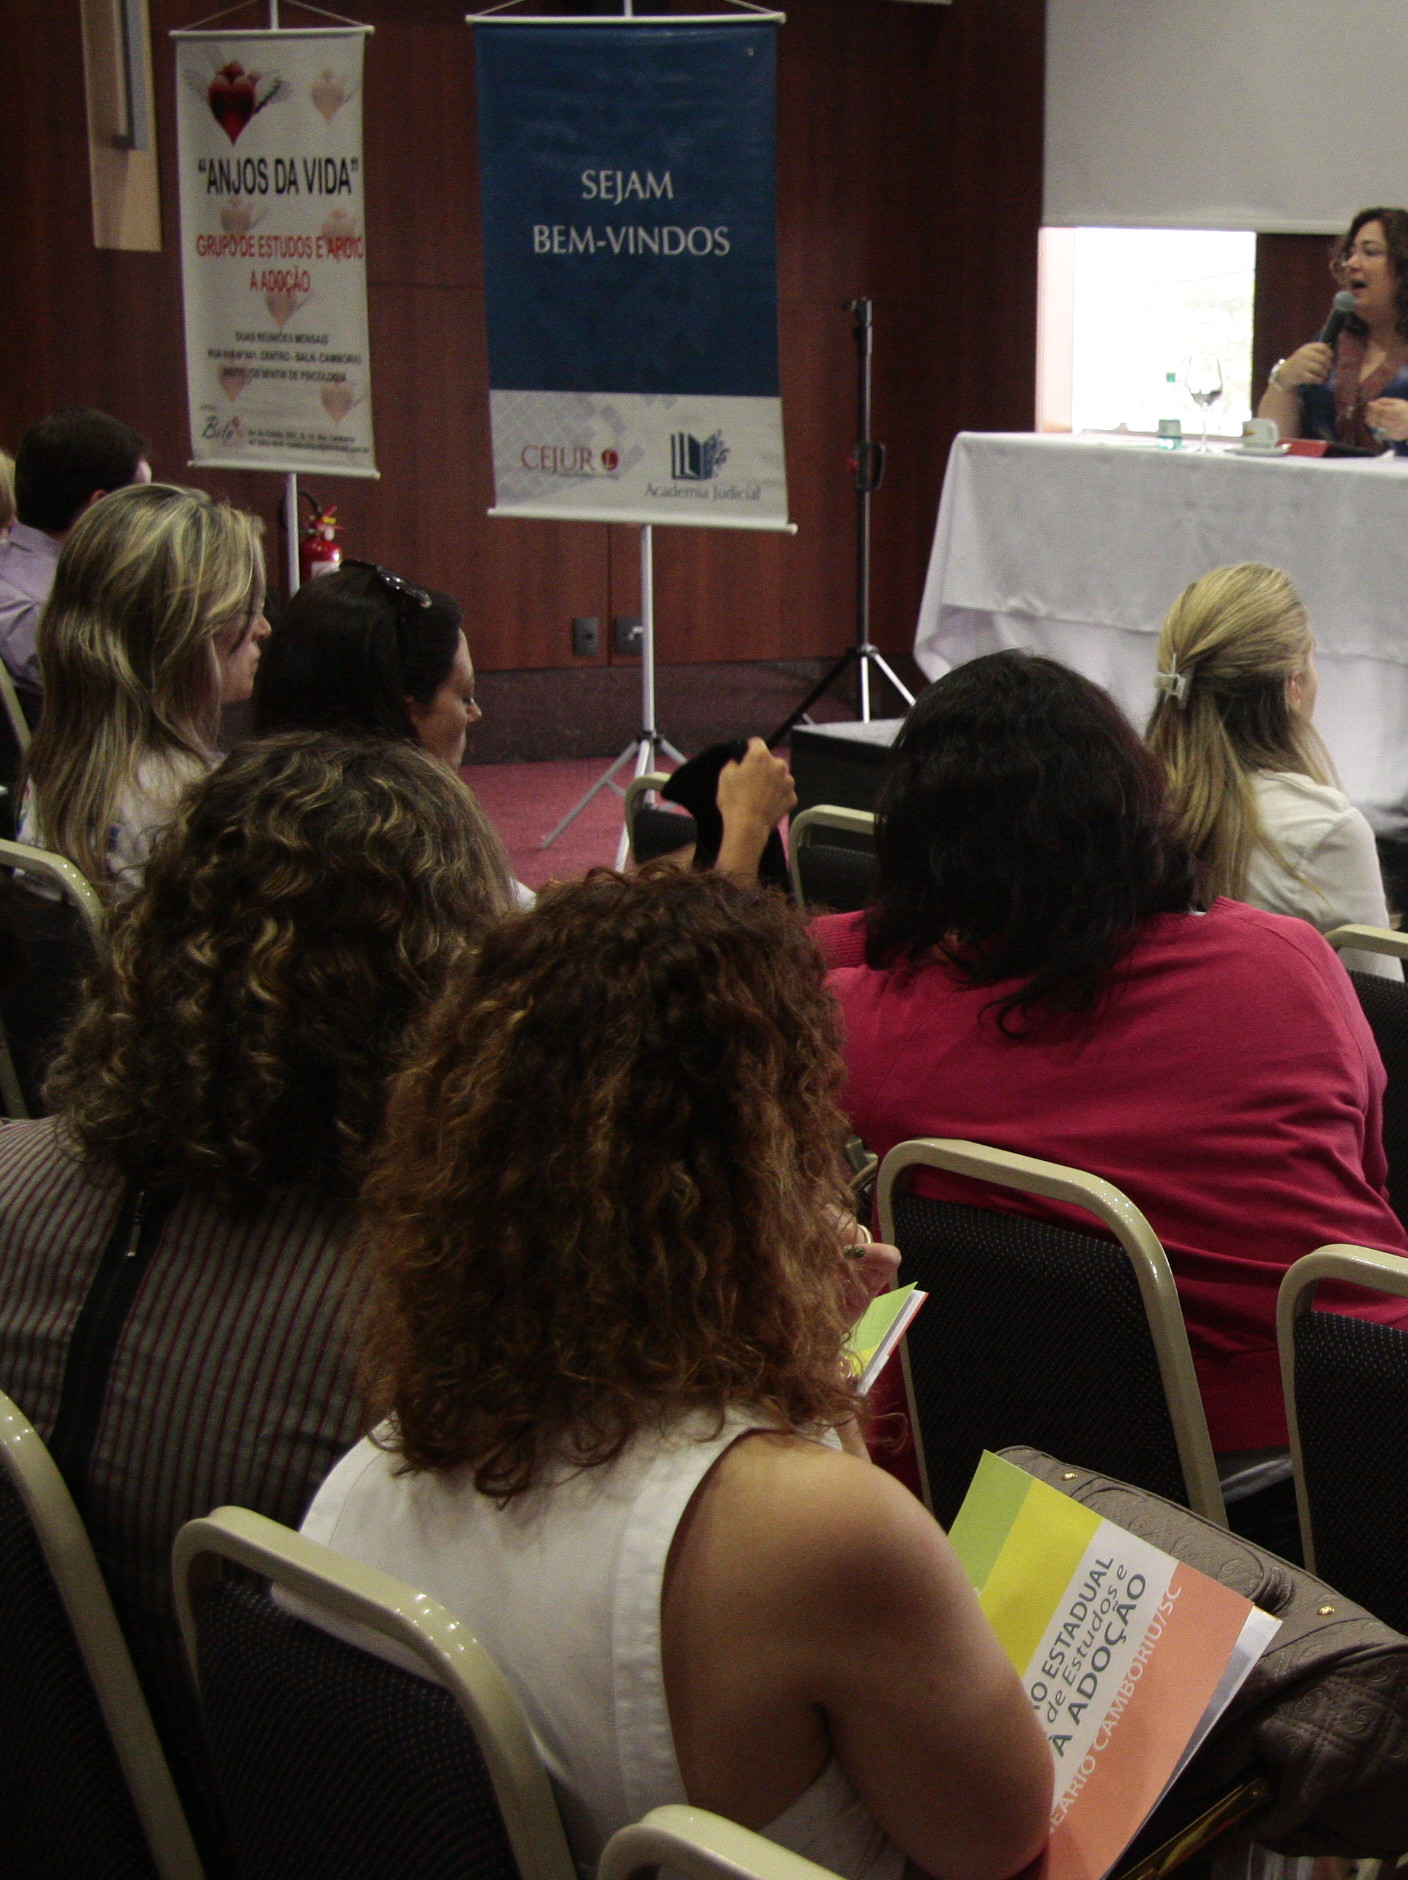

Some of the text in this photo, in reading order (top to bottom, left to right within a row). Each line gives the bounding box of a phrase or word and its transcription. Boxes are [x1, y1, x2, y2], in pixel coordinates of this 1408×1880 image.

[274, 157, 299, 196] DA
[581, 169, 674, 206] SEJAM
[196, 233, 237, 257] GRUPO
[239, 234, 256, 257] DE
[258, 235, 313, 259] ESTUDOS
[316, 236, 325, 259] E
[533, 224, 731, 257] BEM-VINDOS
[520, 444, 595, 474] CEJUR
[645, 483, 761, 501] Academia Judicial
[1041, 1557, 1114, 1680] ESTADUAL
[1047, 1563, 1129, 1723] de Estudos e
[1067, 1573, 1147, 1726] ADOÇÃO
[1050, 1754, 1096, 1834] EARIO
